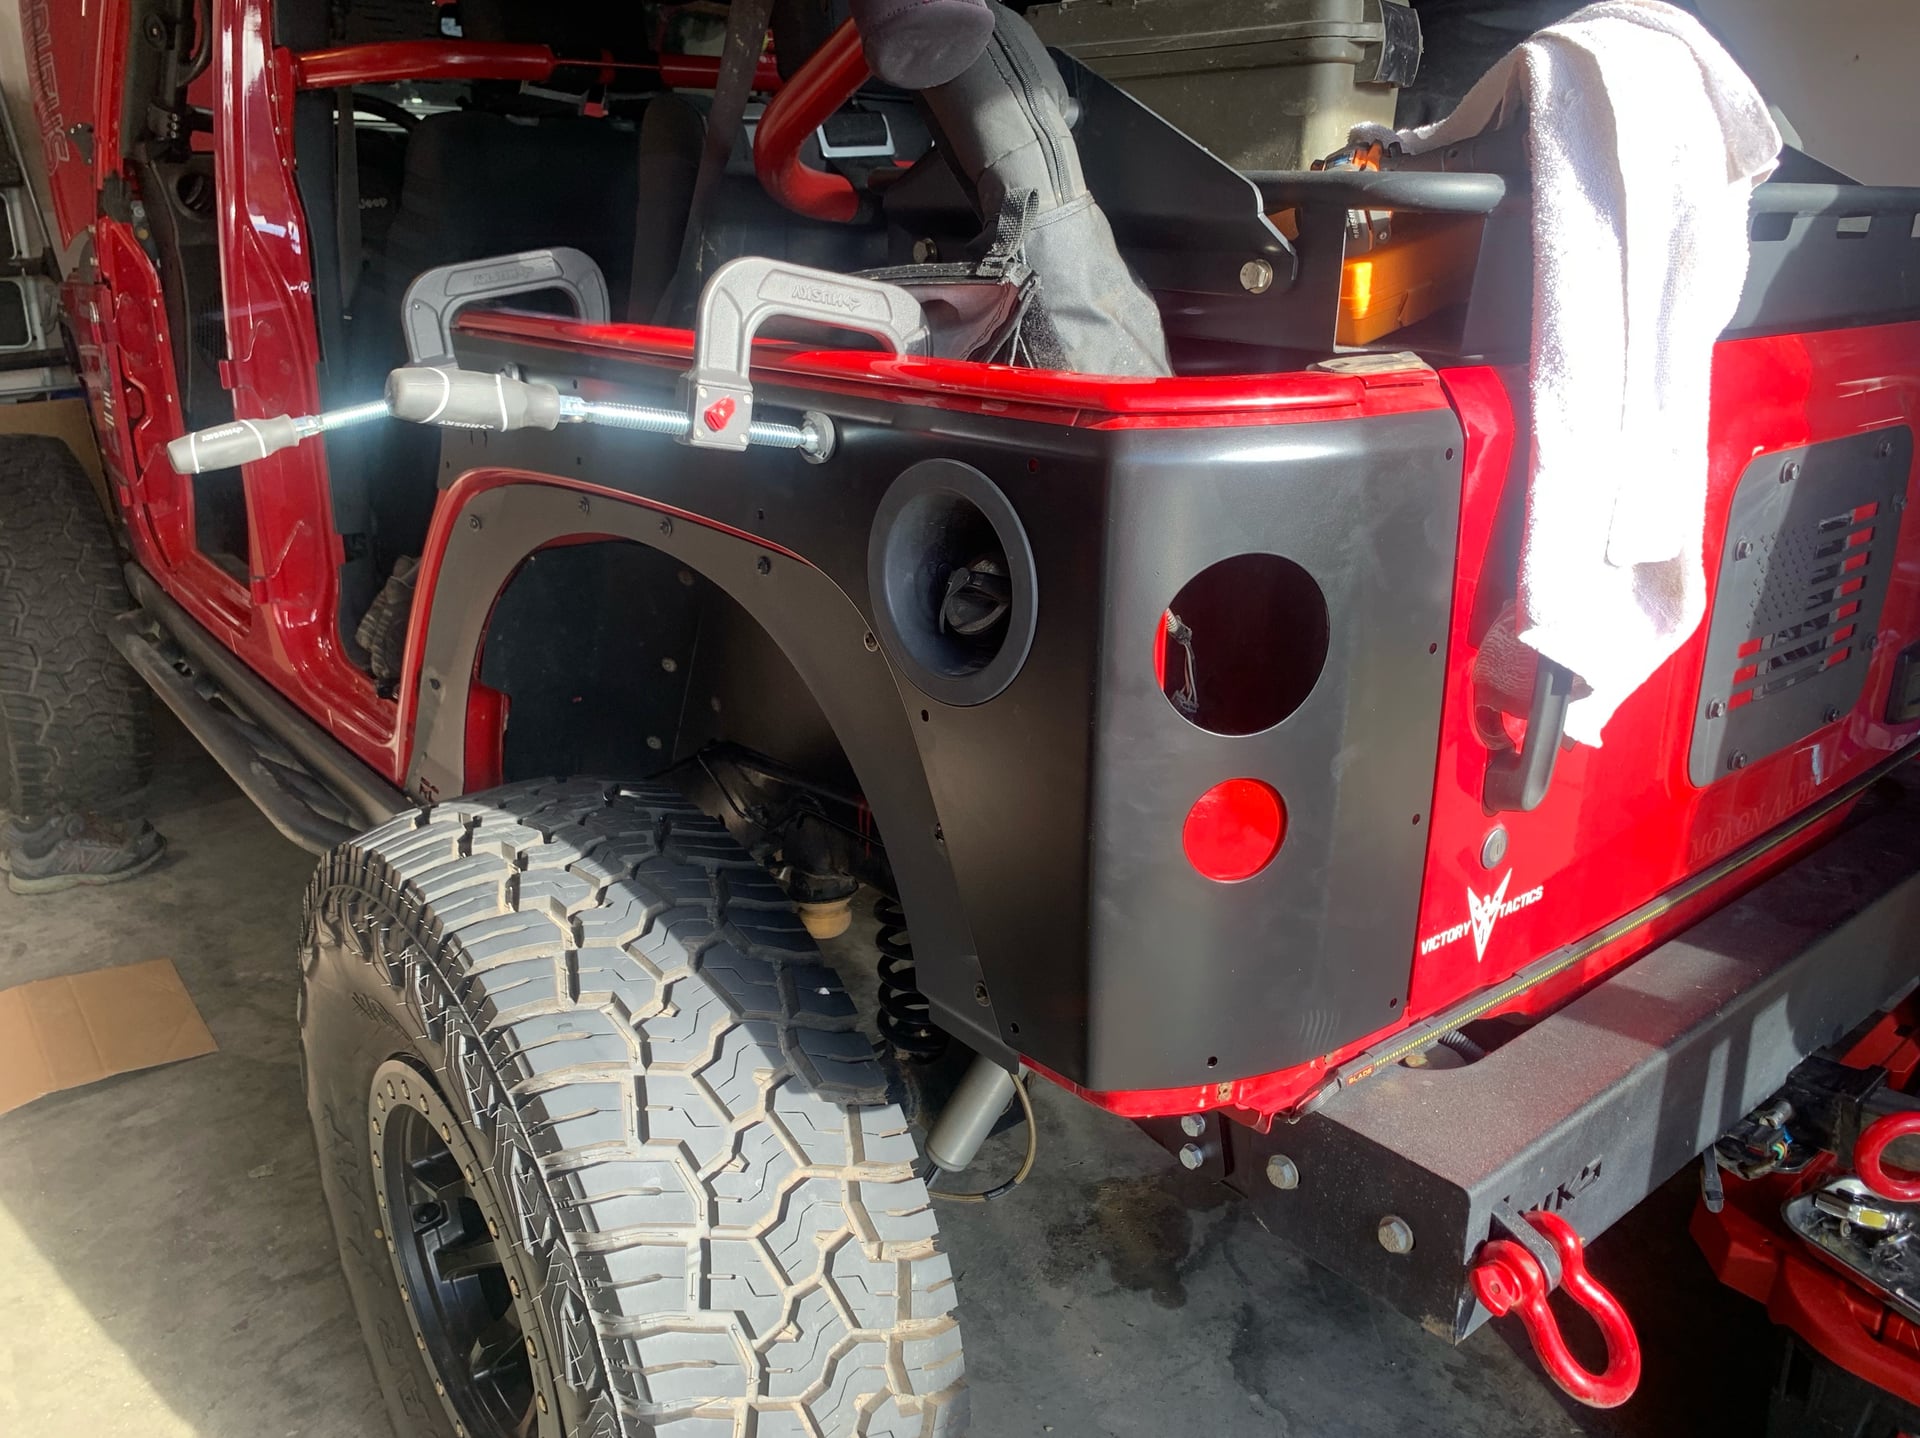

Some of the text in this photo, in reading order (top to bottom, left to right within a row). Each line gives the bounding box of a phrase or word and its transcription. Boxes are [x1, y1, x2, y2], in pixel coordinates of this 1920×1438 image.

[791, 284, 843, 308] HUSKY
[438, 420, 481, 430] HUSKY
[202, 427, 235, 442] HUSKY
[1421, 885, 1543, 955] VICTORY TACTICS
[1348, 1067, 1372, 1084] BLADE
